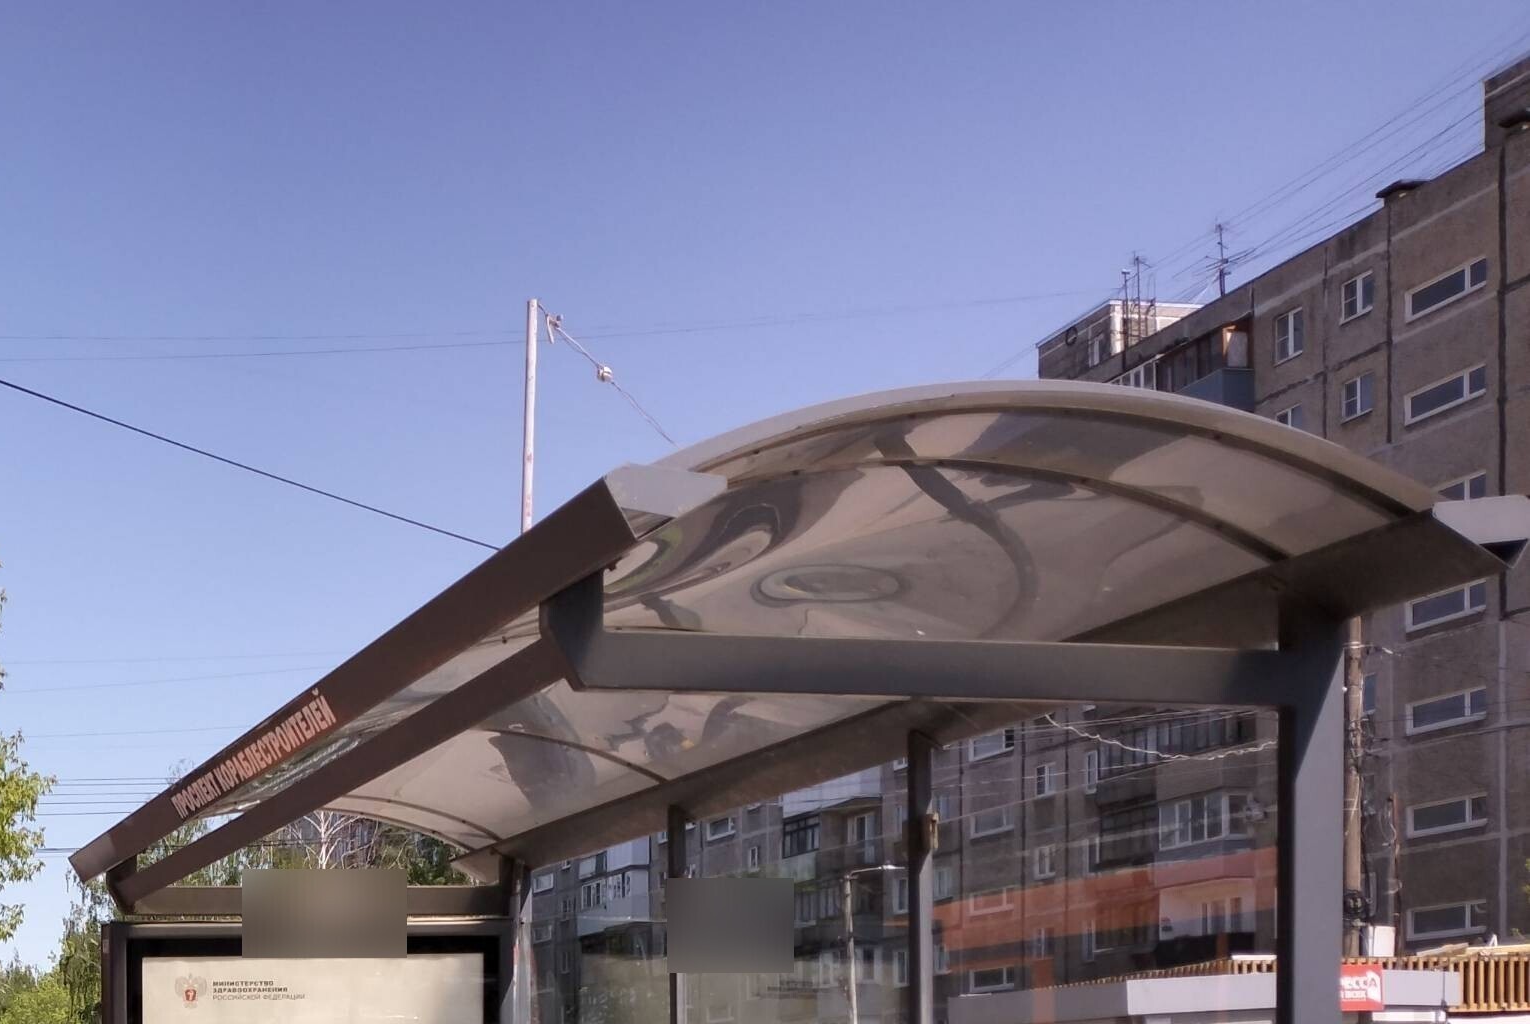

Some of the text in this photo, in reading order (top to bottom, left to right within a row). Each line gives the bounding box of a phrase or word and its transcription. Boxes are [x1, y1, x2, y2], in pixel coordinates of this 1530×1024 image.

[171, 687, 337, 819] ПРОСПЕКТ КОРАБЛЕСТРОИТЕЛЕЙ
[212, 993, 306, 1001] РОССИЙСКОЙ ФЕДЕРАЦИИ
